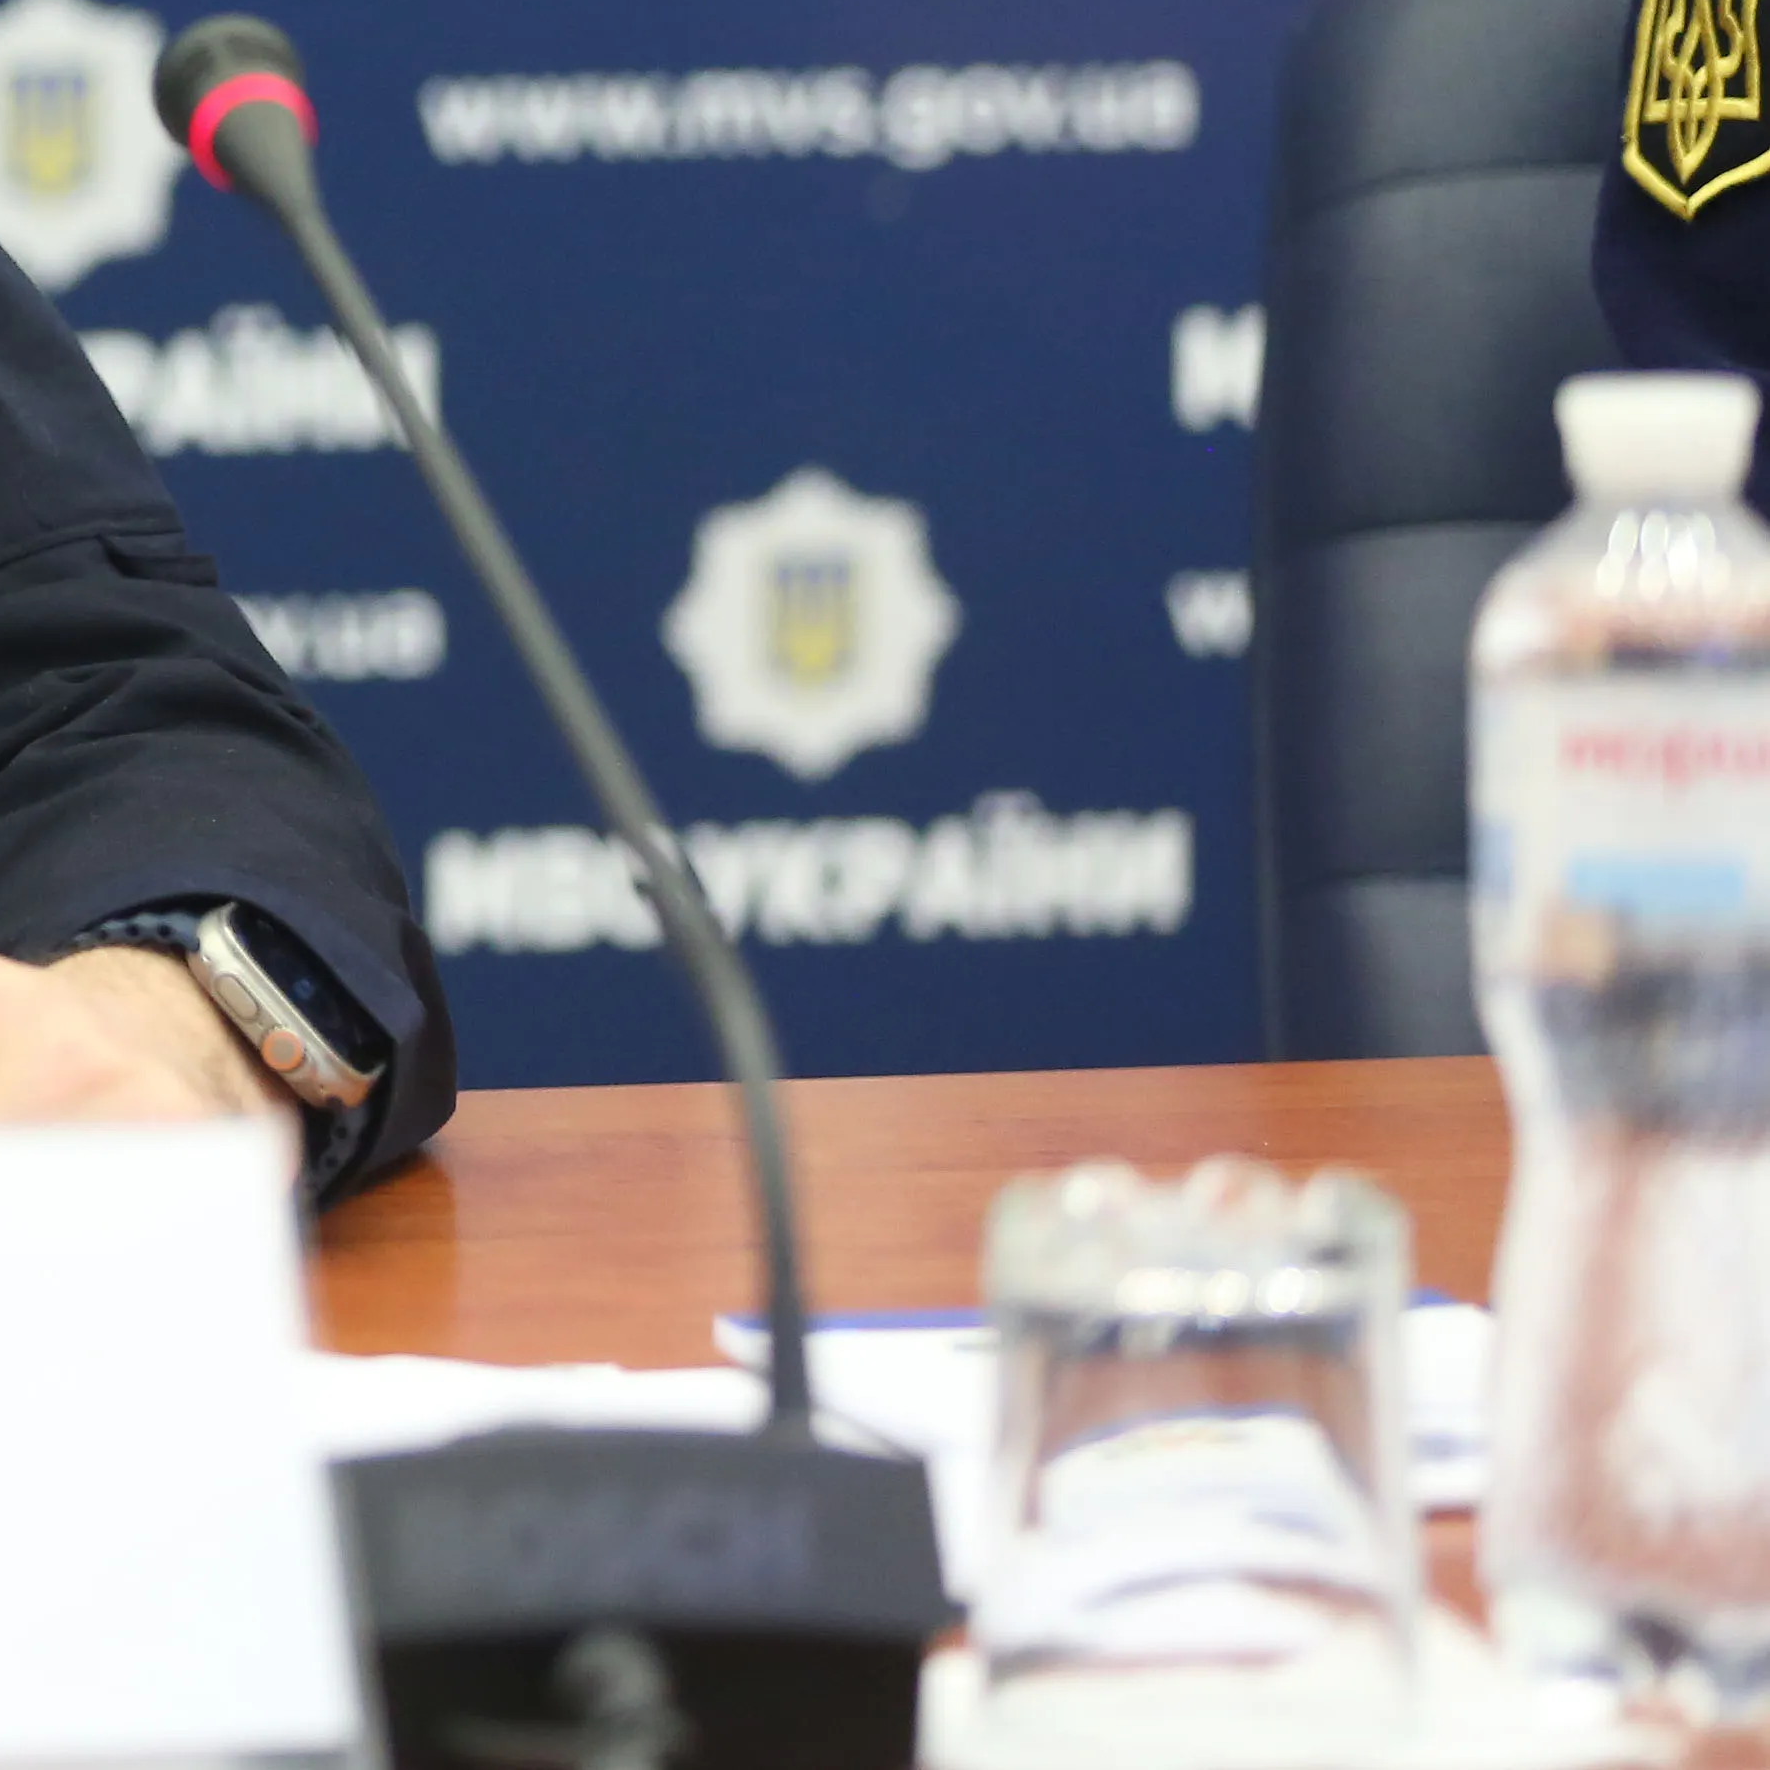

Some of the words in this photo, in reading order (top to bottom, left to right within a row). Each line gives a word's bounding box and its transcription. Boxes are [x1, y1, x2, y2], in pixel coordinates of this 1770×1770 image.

[420, 60, 1200, 170] www.mvs.gov.ua
[426, 827, 682, 951] МВС
[684, 788, 1192, 944] УКРАЇНИ
